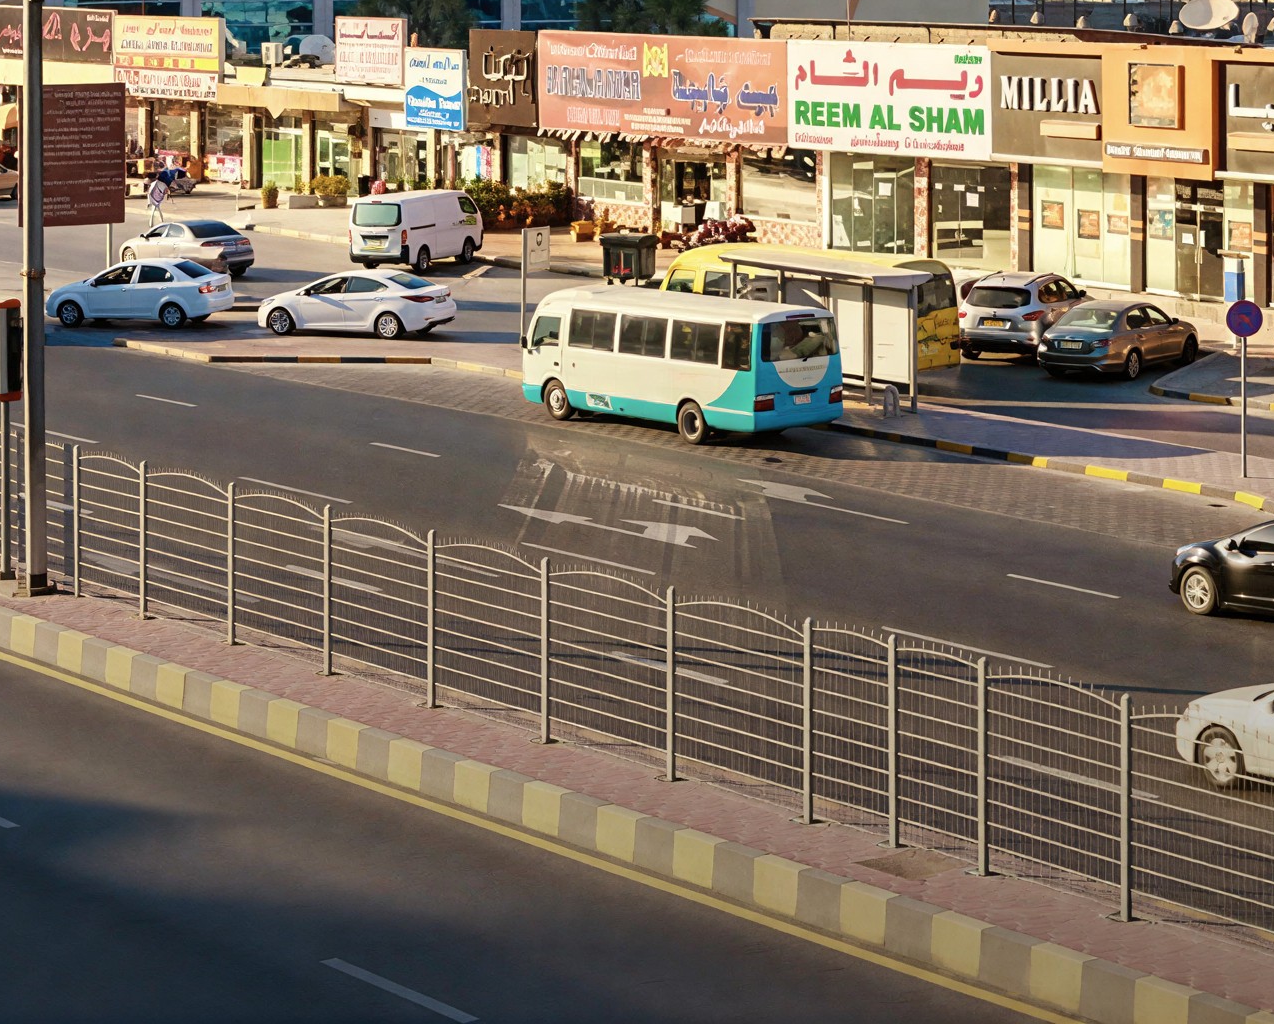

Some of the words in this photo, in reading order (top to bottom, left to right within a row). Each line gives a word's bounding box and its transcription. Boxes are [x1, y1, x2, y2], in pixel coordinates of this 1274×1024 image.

[1000, 75, 1100, 114] MILLIA
[795, 100, 862, 128] REEM
[869, 104, 902, 131] AL
[908, 105, 985, 135] SHAM
